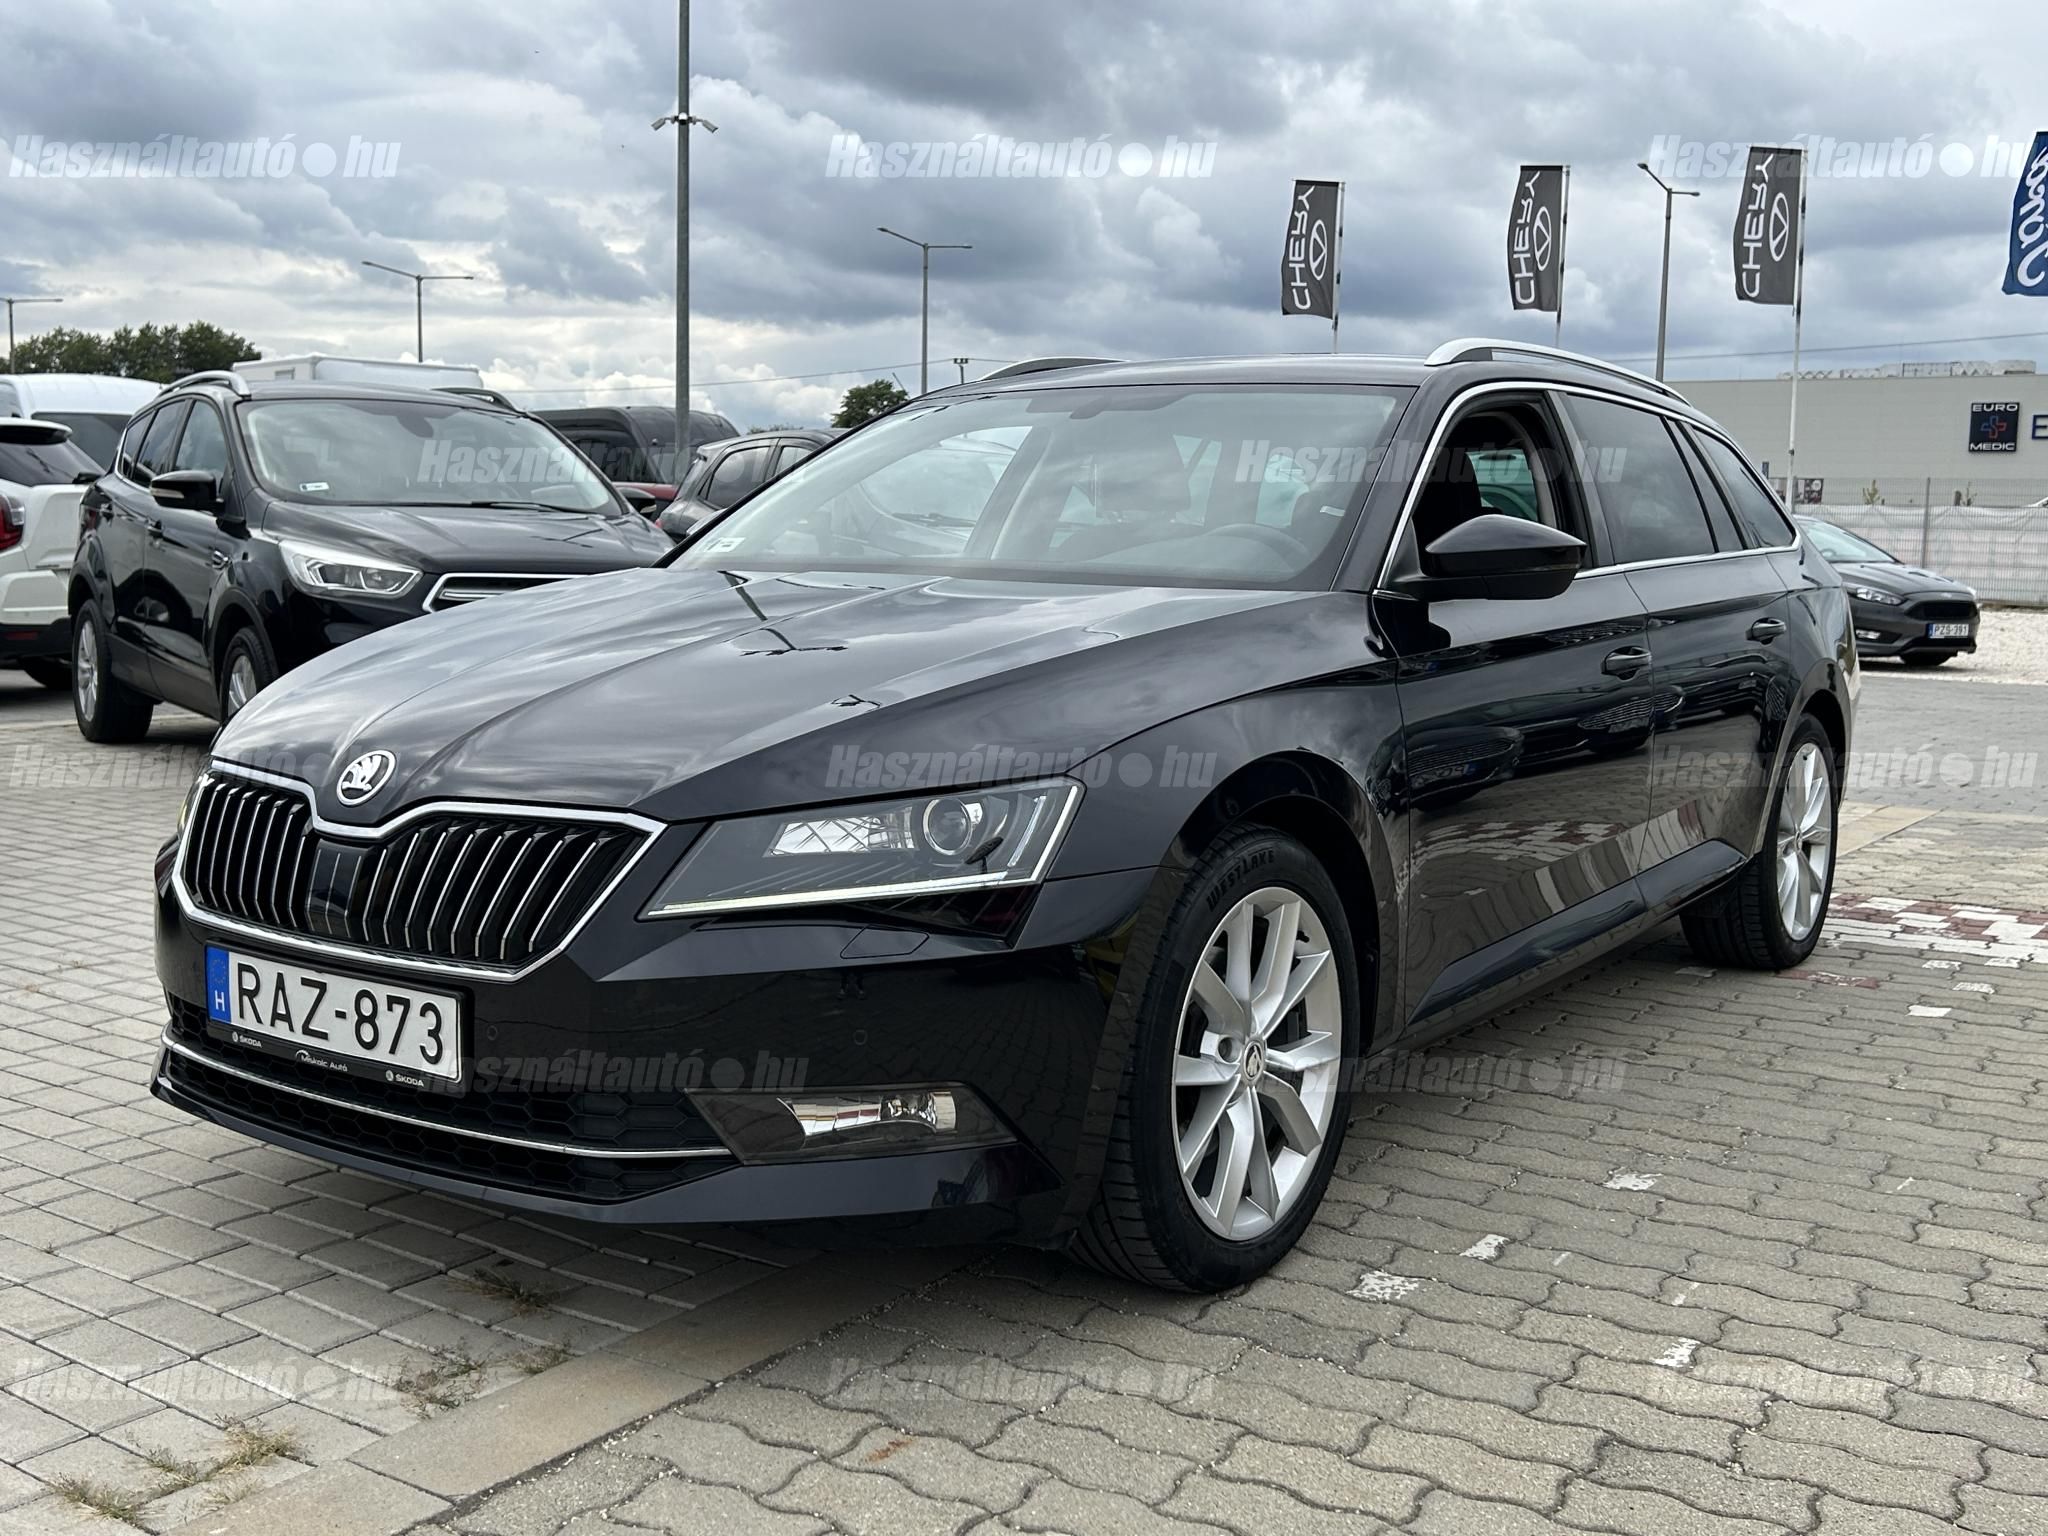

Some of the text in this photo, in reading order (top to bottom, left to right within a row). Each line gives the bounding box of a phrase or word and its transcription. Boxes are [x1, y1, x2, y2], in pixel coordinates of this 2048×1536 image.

[1972, 404, 2018, 412] EURO
[1970, 442, 2015, 451] MEDIC
[214, 991, 225, 1012] H
[238, 962, 443, 1064] RAZ-873
